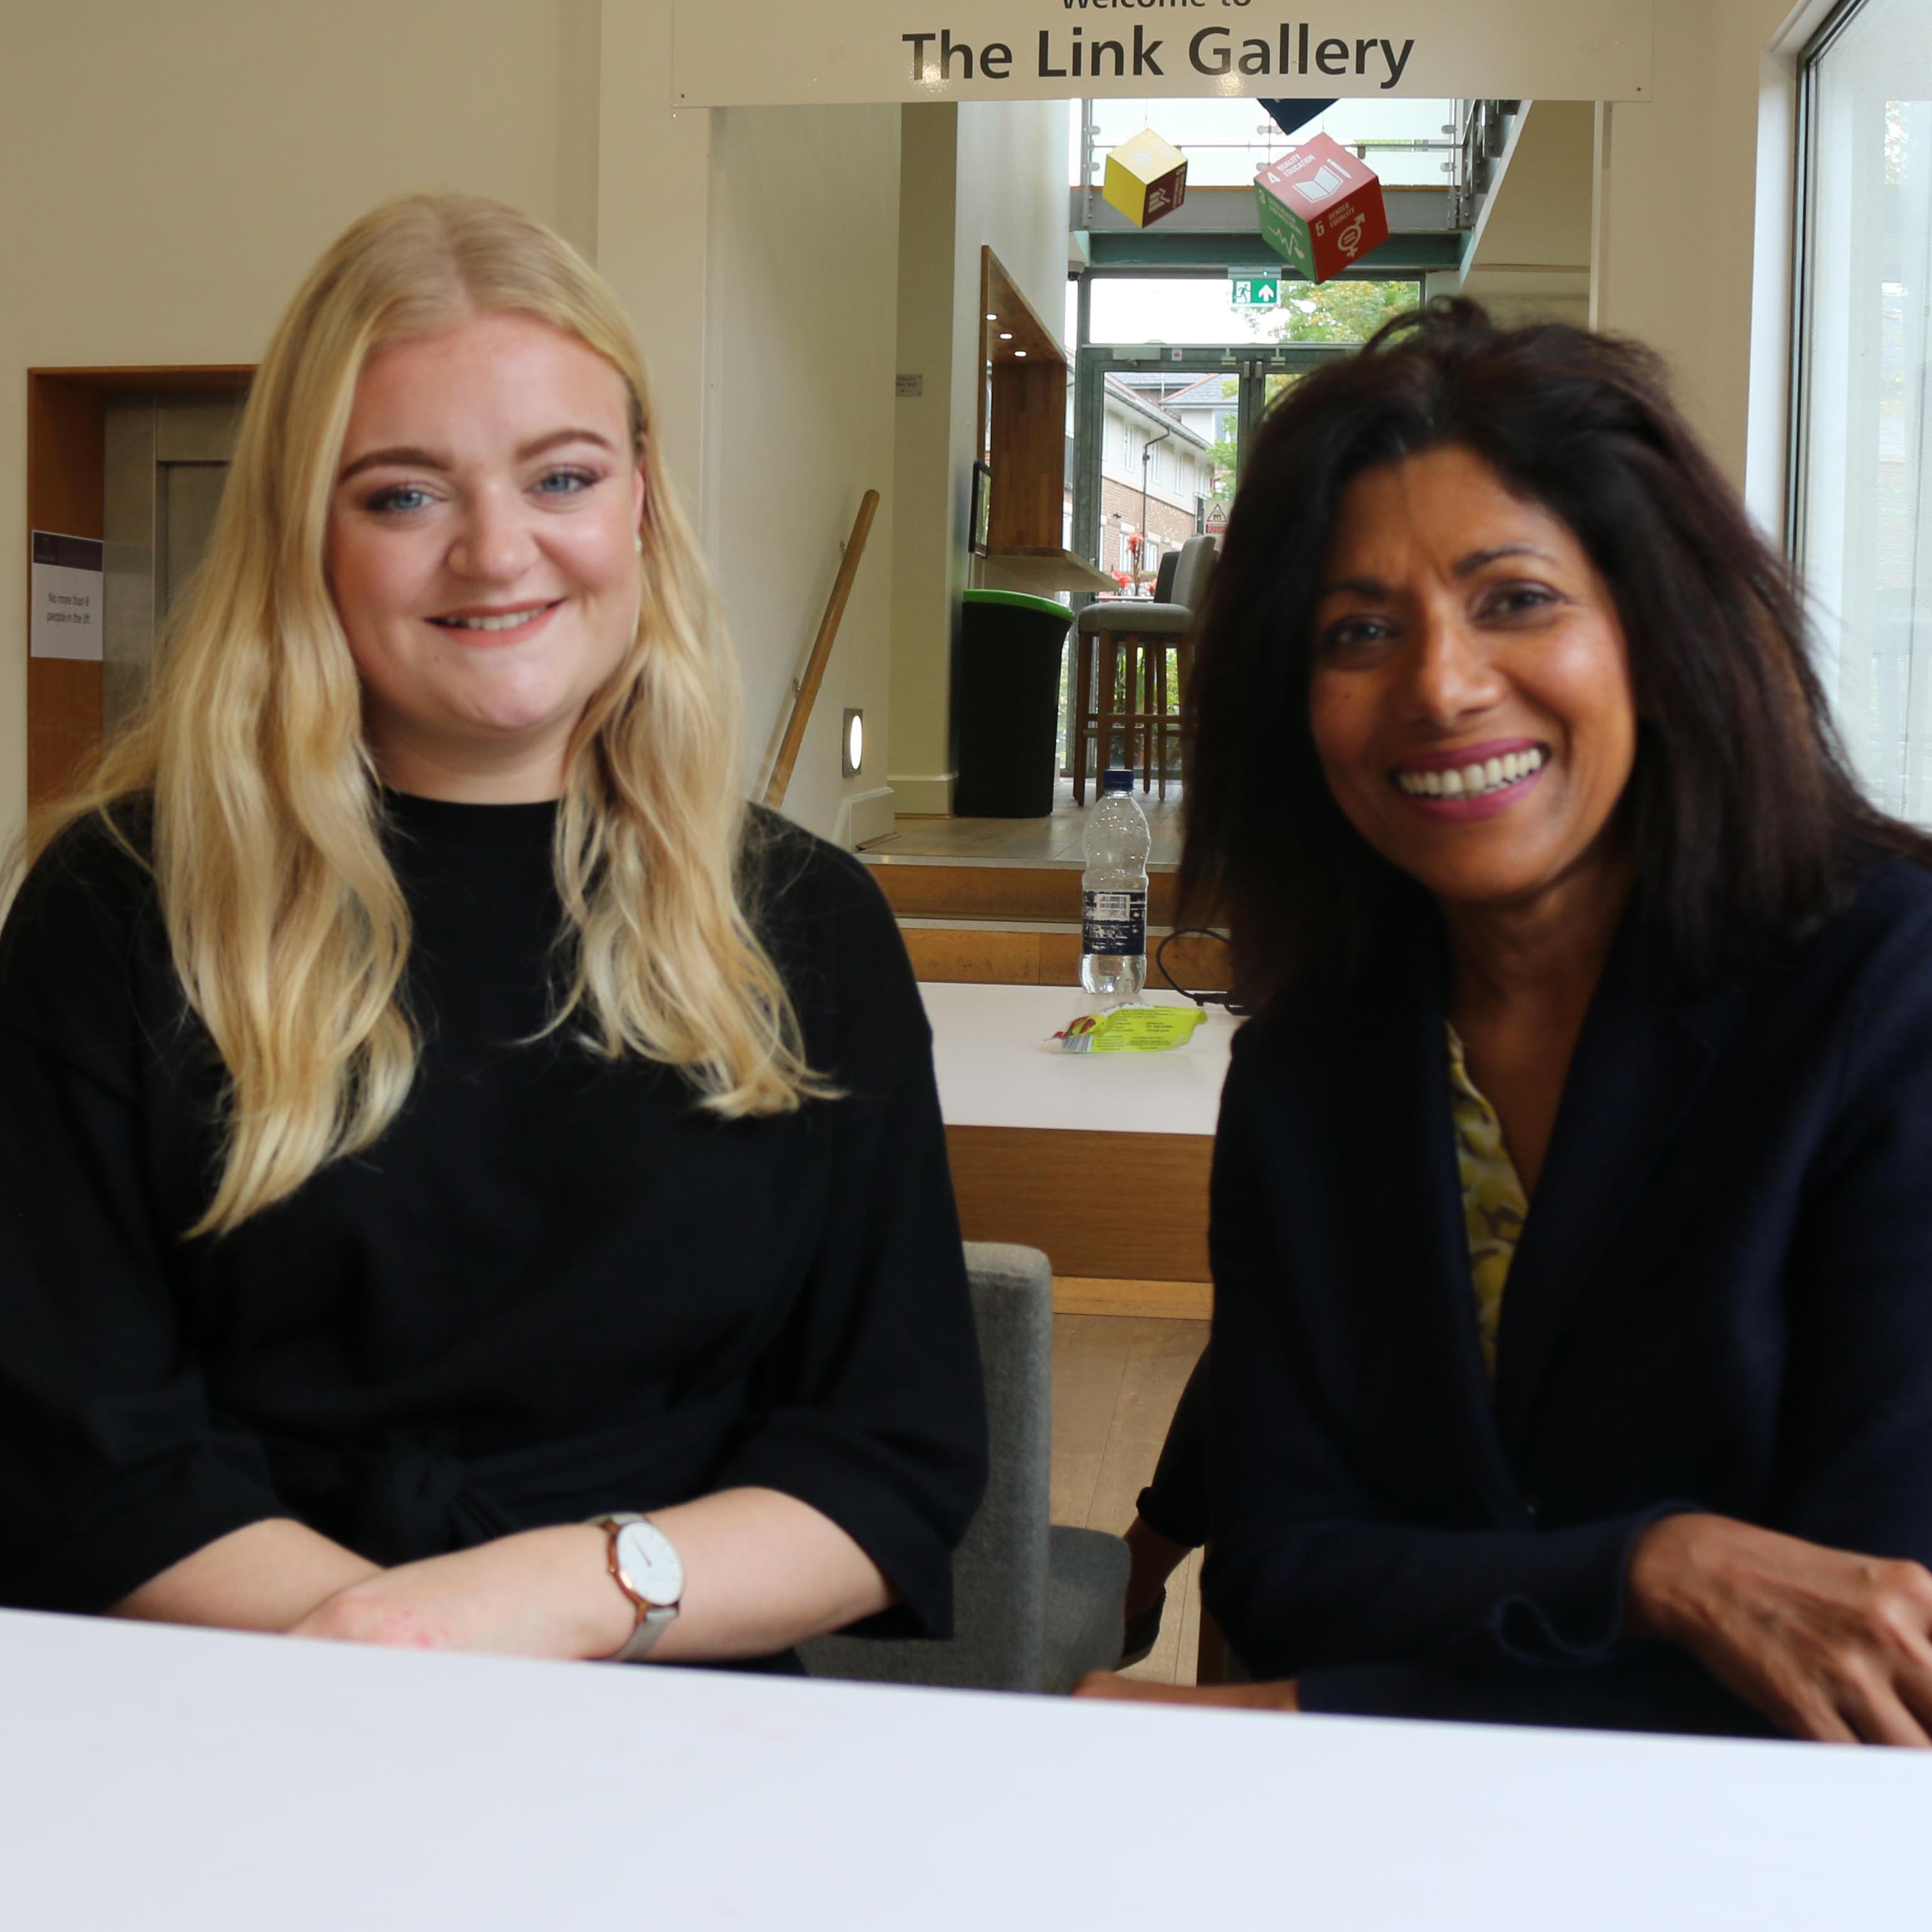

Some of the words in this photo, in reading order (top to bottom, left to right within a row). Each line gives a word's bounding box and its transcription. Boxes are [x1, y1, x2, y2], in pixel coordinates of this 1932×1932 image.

[902, 29, 1013, 80] The
[1038, 25, 1164, 77] Link
[1189, 23, 1415, 89] Gallery
[1277, 153, 1301, 172] QUALITY
[1283, 155, 1316, 177] EDUCATION
[1267, 171, 1281, 184] 4
[1315, 220, 1325, 237] 5
[48, 592, 57, 604] No
